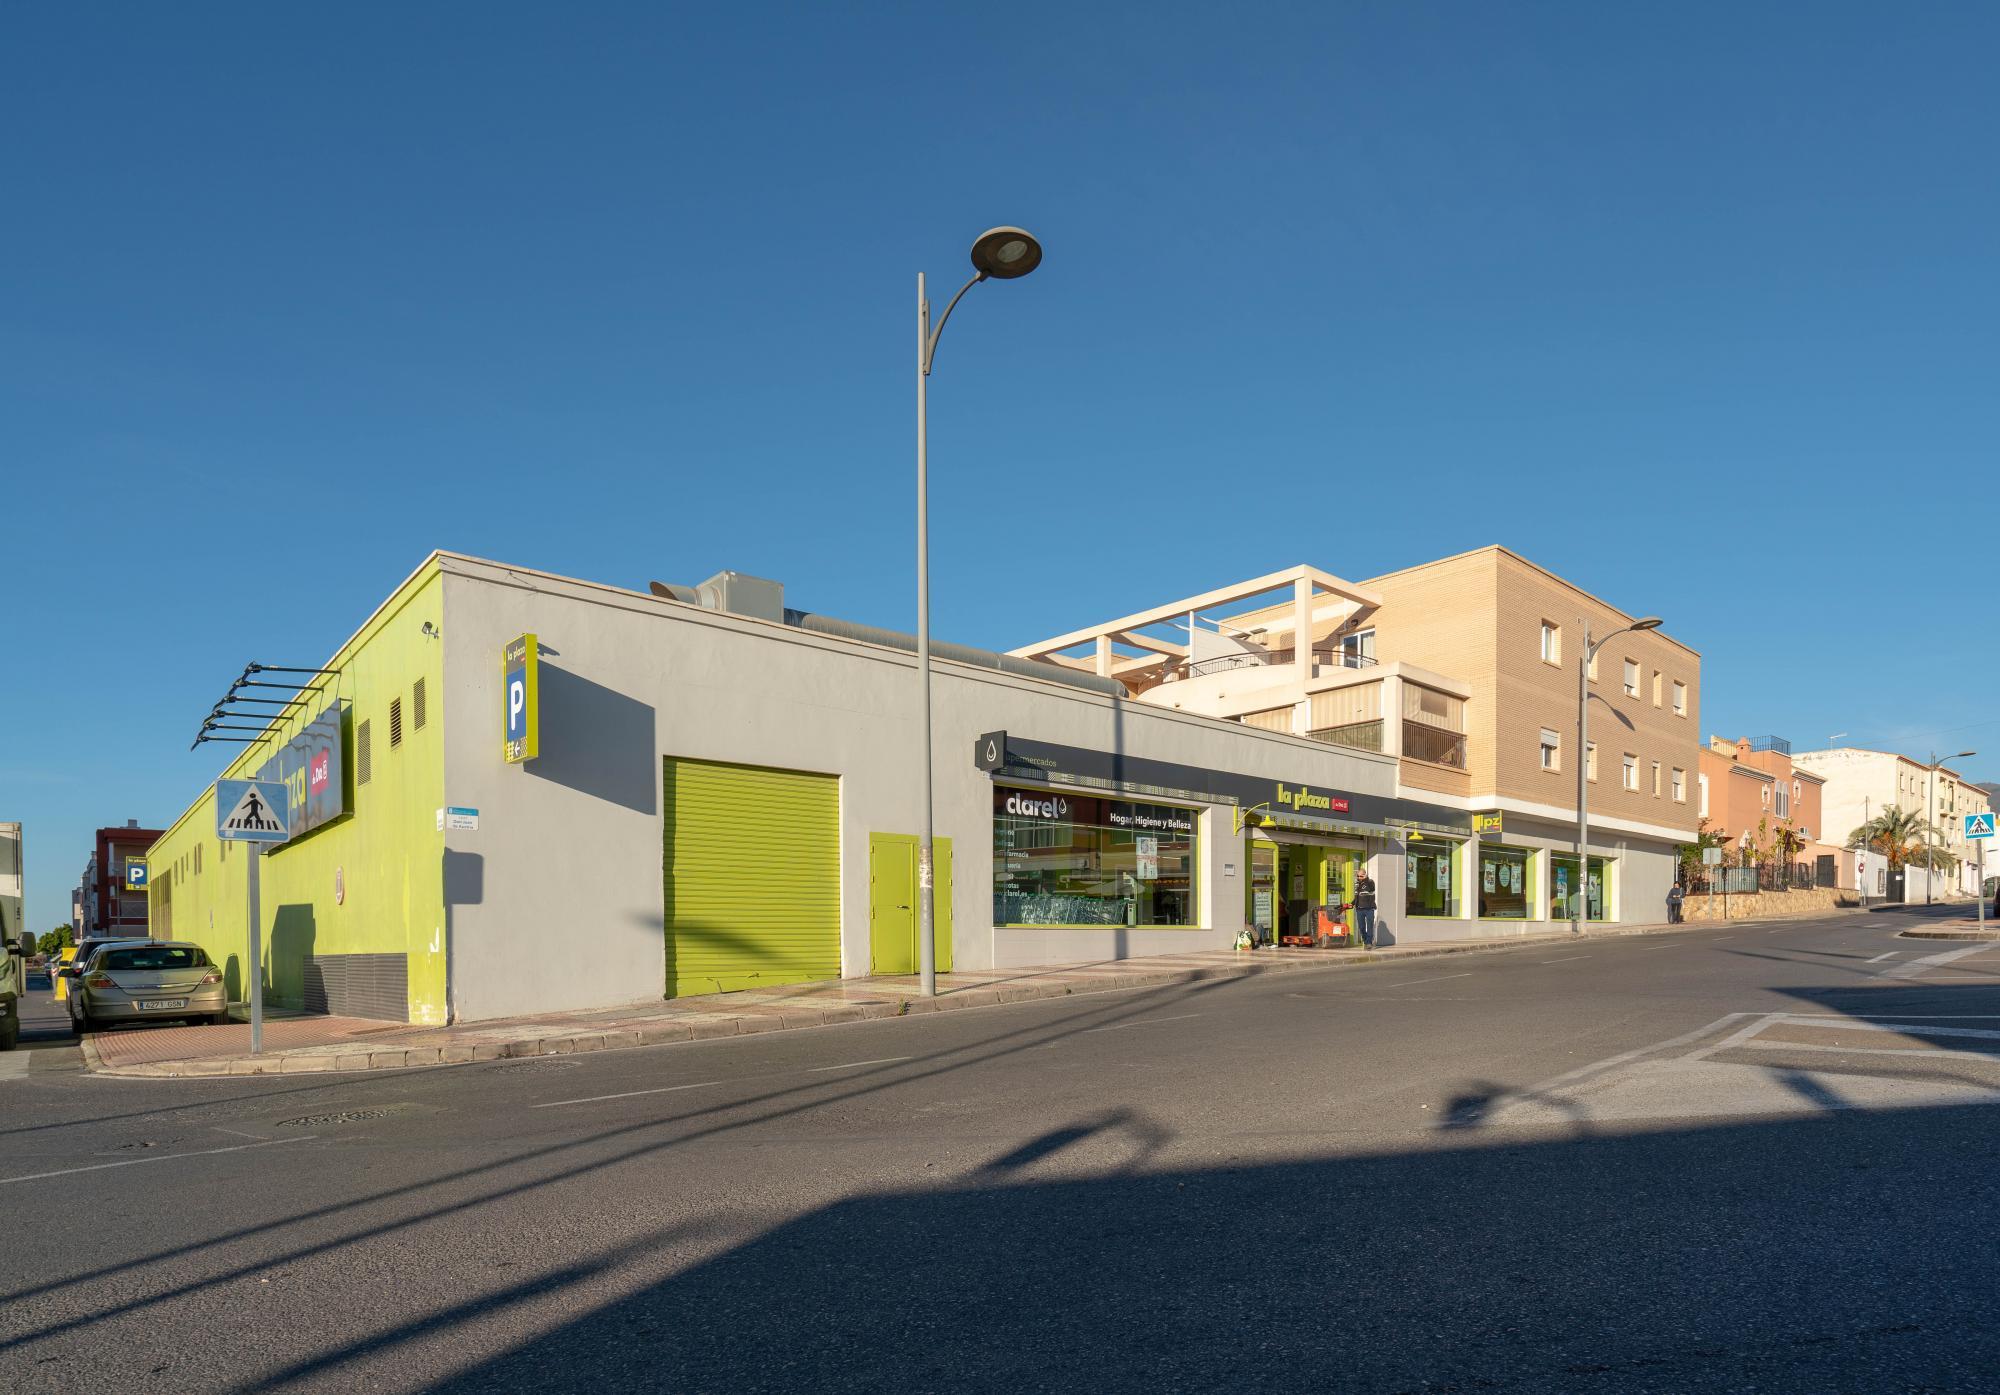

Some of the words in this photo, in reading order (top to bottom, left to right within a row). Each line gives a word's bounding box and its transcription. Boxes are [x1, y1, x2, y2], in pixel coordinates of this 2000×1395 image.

[511, 680, 523, 731] P
[1005, 754, 1057, 768] upermercados
[1006, 793, 1058, 819] clarel
[1277, 783, 1292, 804] la
[1294, 786, 1330, 811] plaza
[1110, 812, 1134, 825] Hogar,
[1135, 815, 1162, 828] Higiene
[1162, 820, 1168, 829] y
[1168, 818, 1192, 830] Belleza
[130, 867, 144, 882] P
